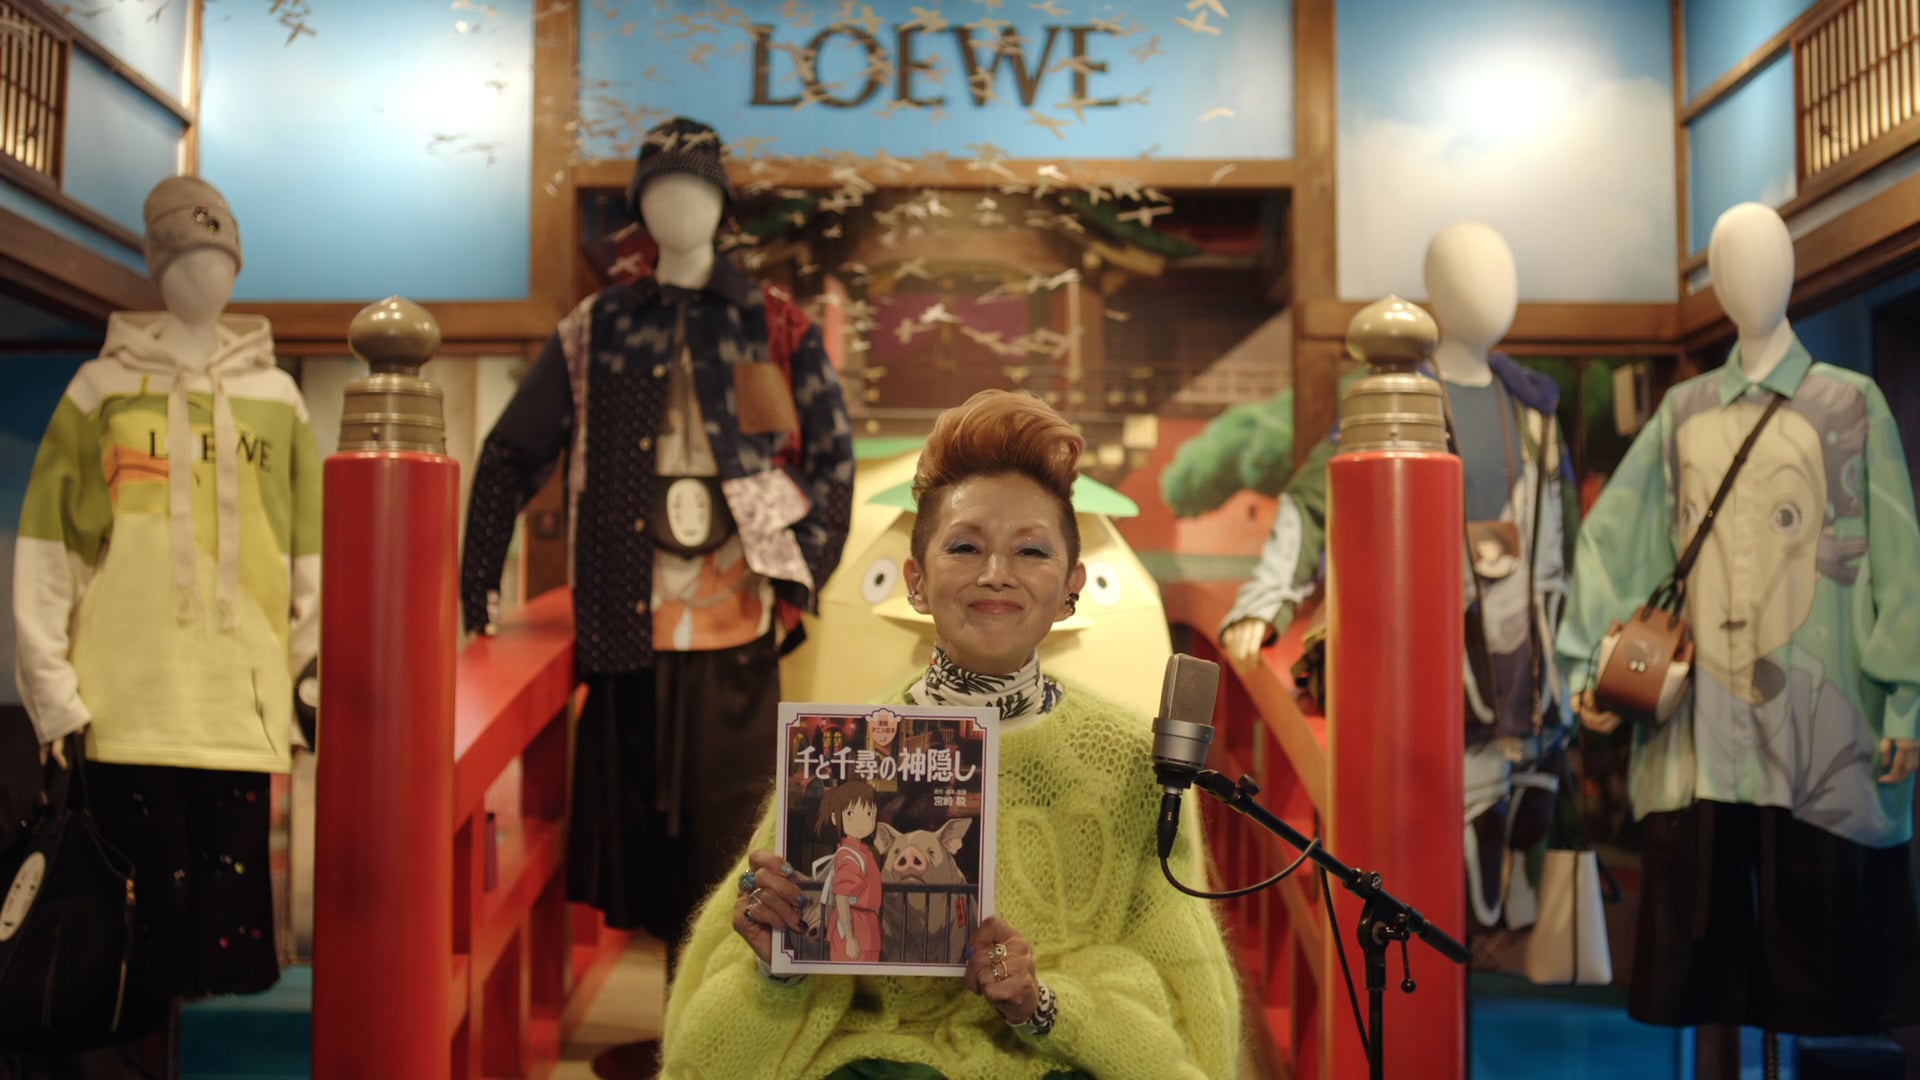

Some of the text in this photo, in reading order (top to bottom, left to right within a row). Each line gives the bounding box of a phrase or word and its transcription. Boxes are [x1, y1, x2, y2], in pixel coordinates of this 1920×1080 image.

[748, 23, 1121, 108] LOEWE
[794, 745, 977, 783] 千と千尋の神隠し
